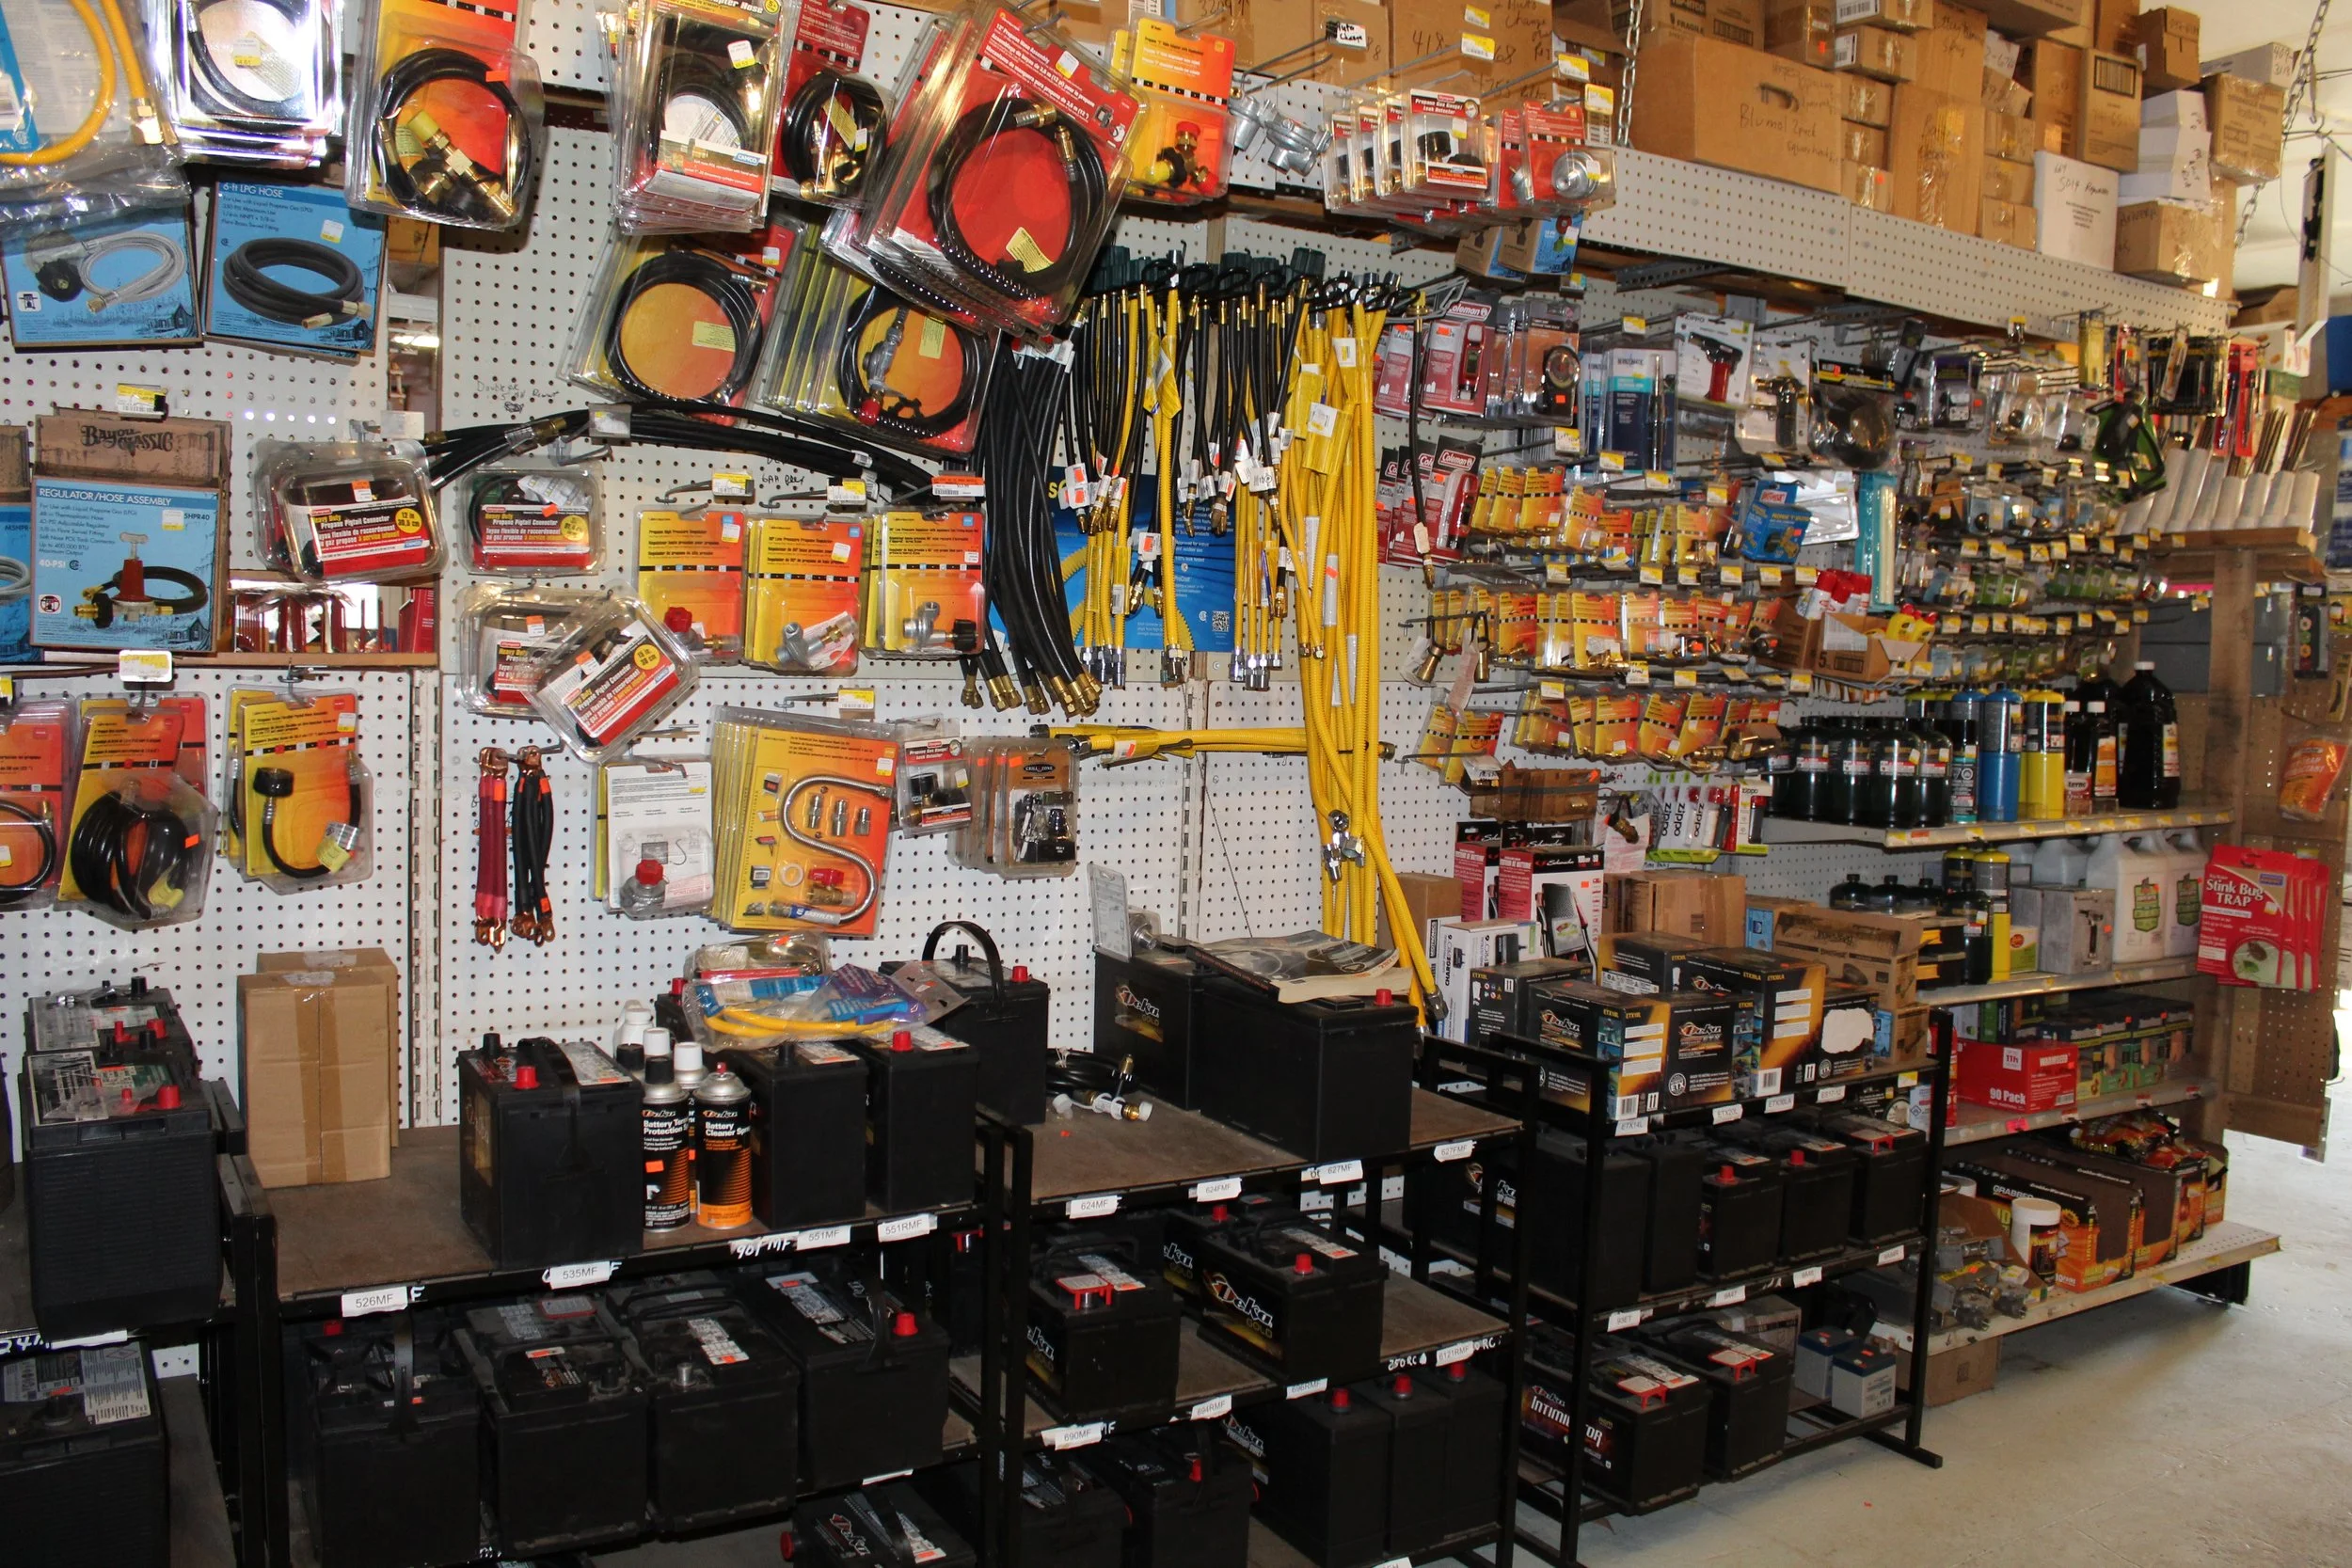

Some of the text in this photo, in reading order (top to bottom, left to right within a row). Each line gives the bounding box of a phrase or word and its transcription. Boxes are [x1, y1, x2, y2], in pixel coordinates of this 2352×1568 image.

[240, 184, 256, 195] LPG
[259, 187, 283, 198] HOSE
[1451, 303, 1480, 316] oleman
[126, 495, 172, 507] ASSEMBLY
[321, 515, 389, 530] Propane Pigtail Connector
[1674, 802, 1686, 837] zippo
[1693, 803, 1704, 837] zippo
[2206, 879, 2264, 901] Stink Bug
[2217, 892, 2251, 908] TRAP
[1990, 1087, 2026, 1104] 90 Pack
[644, 1119, 673, 1128] Battery
[644, 1126, 682, 1135] Protection
[706, 1121, 735, 1131] Battery
[706, 1129, 736, 1137] Cleaner
[1439, 1144, 1468, 1156] 627FMF
[1327, 1163, 1353, 1175] 627MF
[1205, 1182, 1232, 1195] 624FMF
[1080, 1200, 1108, 1212] 624MF
[885, 1219, 923, 1235] 551RMF
[808, 1228, 839, 1243] 551MF
[563, 1266, 598, 1280] 535MF
[355, 1292, 393, 1308] 526MF
[1212, 1273, 1274, 1328] Deka
[1246, 1318, 1273, 1339] GOLD
[1064, 1429, 1092, 1441] 690MF
